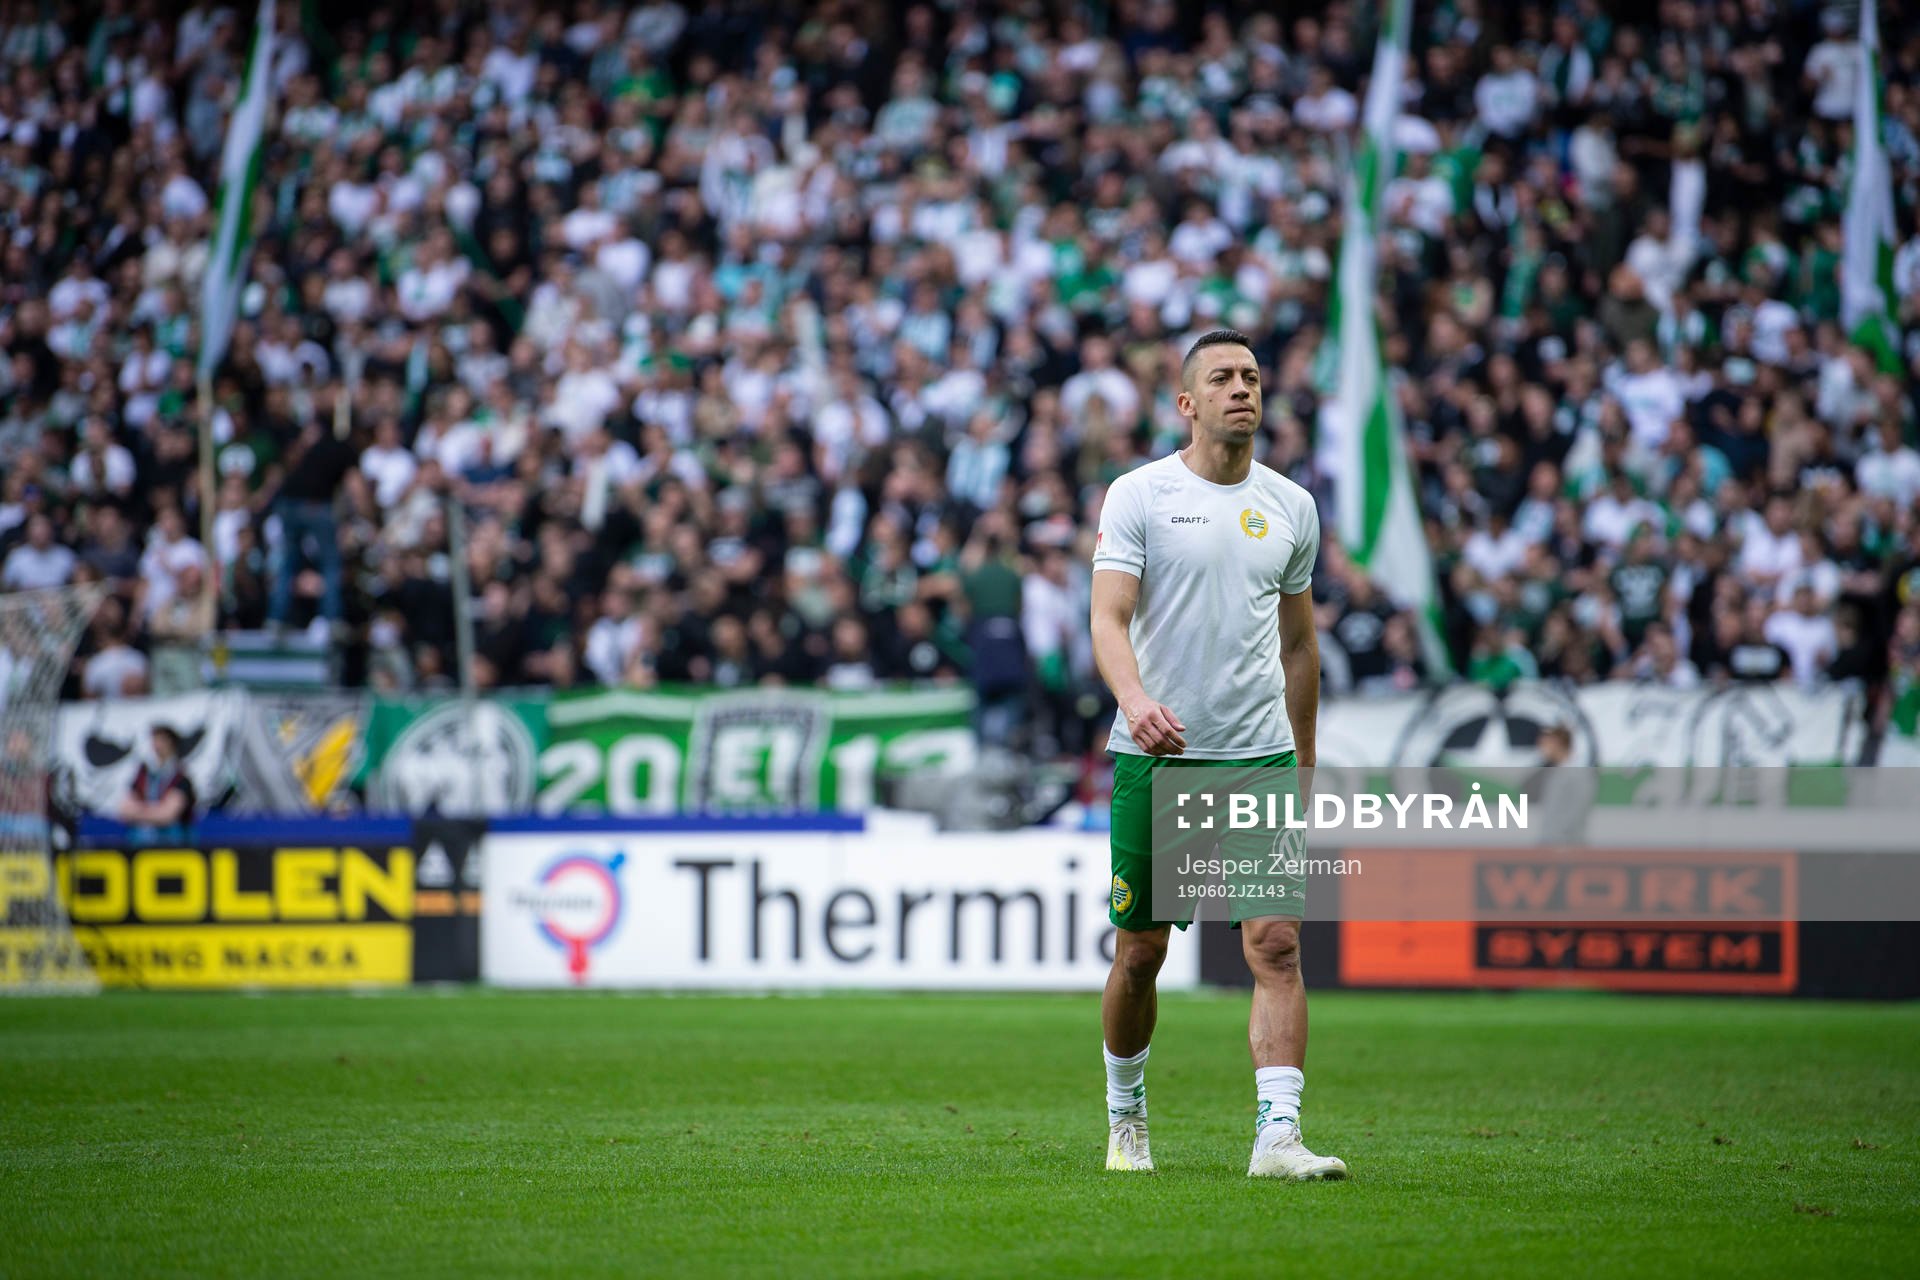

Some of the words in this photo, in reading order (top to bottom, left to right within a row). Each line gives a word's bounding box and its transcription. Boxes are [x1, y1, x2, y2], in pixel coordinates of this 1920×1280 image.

[1171, 516, 1202, 524] CRAFT
[1484, 866, 1764, 912] WORK
[1487, 930, 1762, 968] SYSTEM
